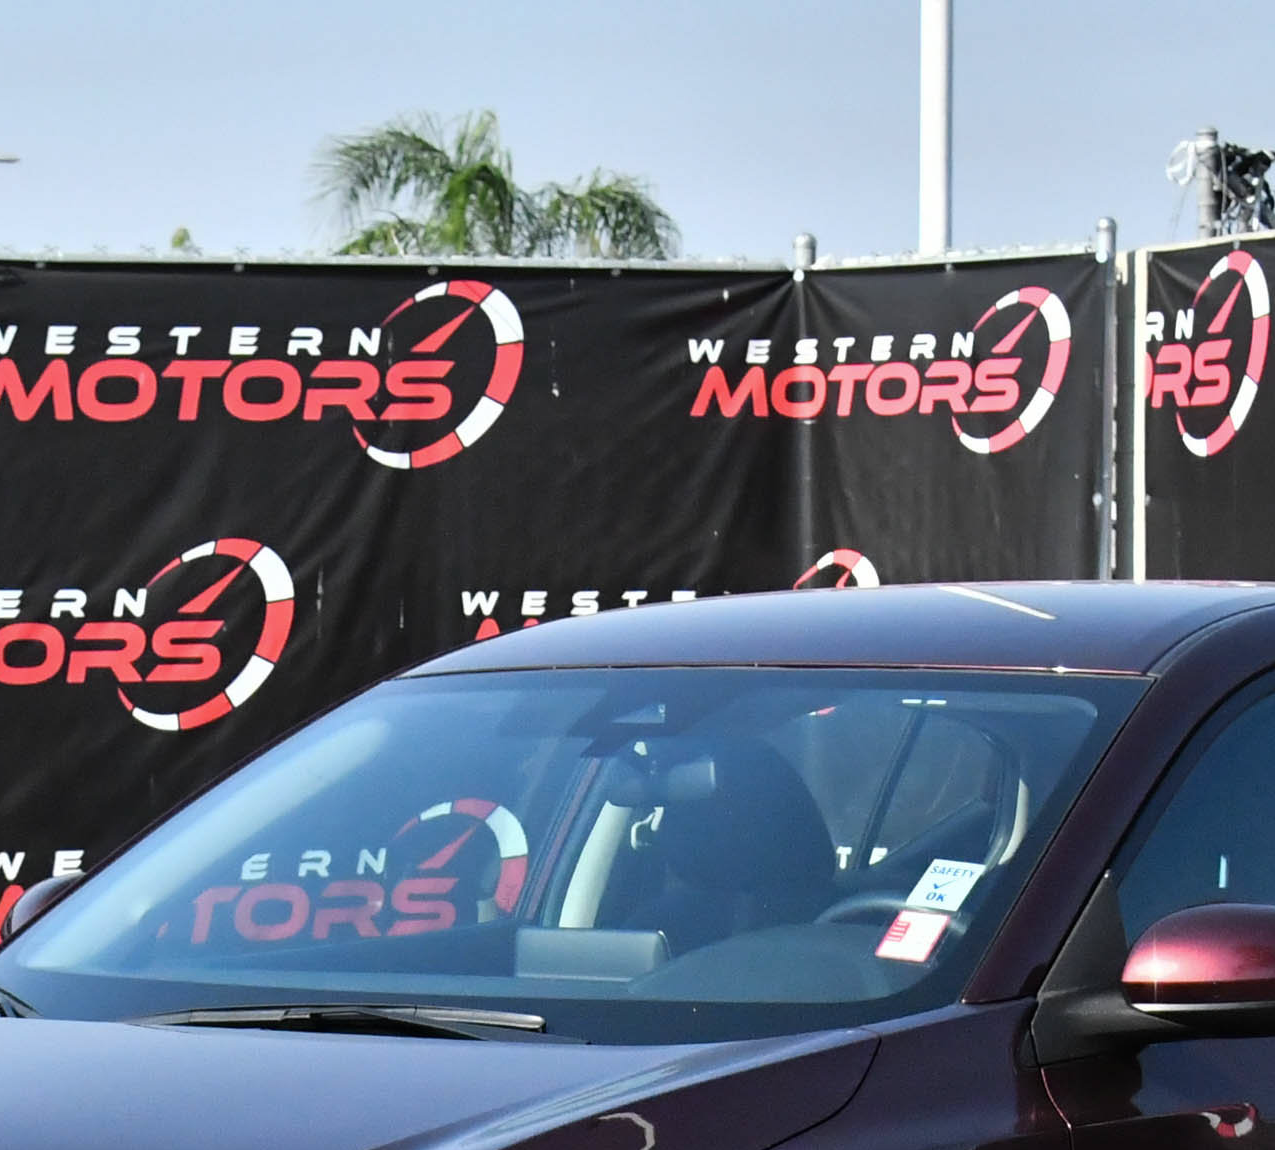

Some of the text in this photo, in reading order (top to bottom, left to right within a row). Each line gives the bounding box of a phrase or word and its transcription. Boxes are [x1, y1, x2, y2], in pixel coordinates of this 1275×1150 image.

[689, 332, 974, 364] WESTERN
[690, 357, 1022, 418] MOTORS
[1145, 338, 1232, 408] RS
[930, 865, 975, 879] SAFETY
[926, 891, 947, 902] OK
